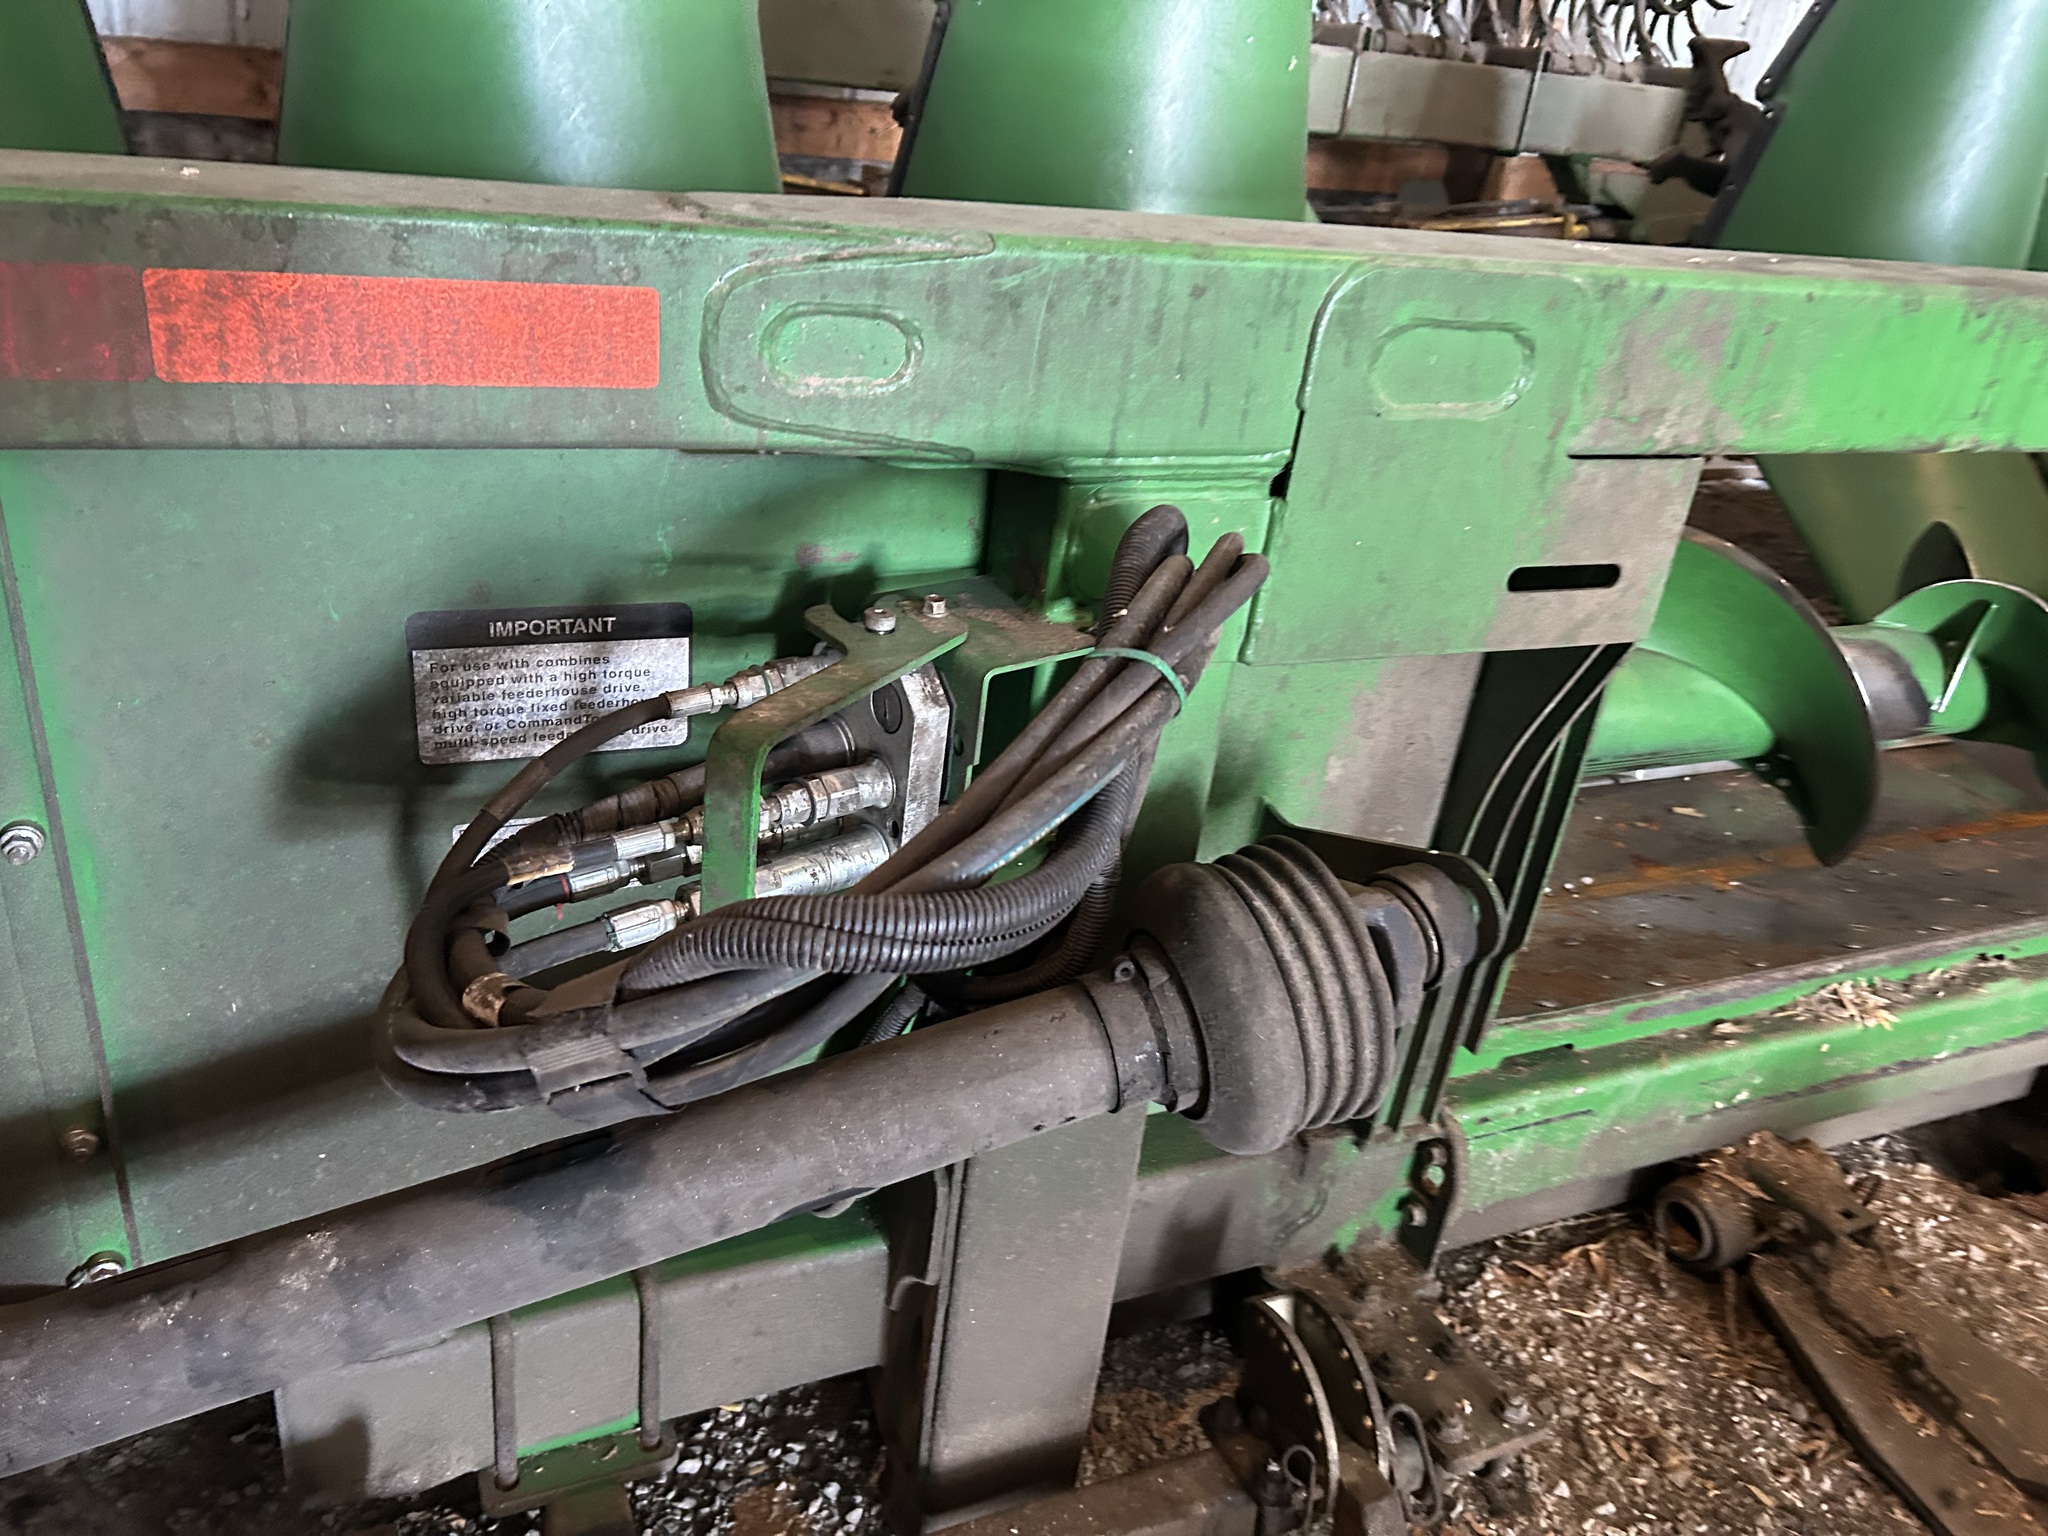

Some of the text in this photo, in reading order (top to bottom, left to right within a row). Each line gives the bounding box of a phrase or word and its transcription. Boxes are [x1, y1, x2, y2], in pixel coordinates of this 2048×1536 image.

[489, 617, 617, 638] IMPORTANT
[430, 655, 610, 673] For use with combines
[430, 668, 651, 690] equipped with a high torque
[431, 683, 646, 704] variable feederhouse drive,
[432, 708, 467, 721] high
[473, 705, 524, 717] torque
[530, 701, 568, 713] fixed
[433, 722, 479, 734] drive,
[485, 721, 500, 731] or
[434, 733, 527, 749] multi-speed
[631, 724, 672, 735] drive.
